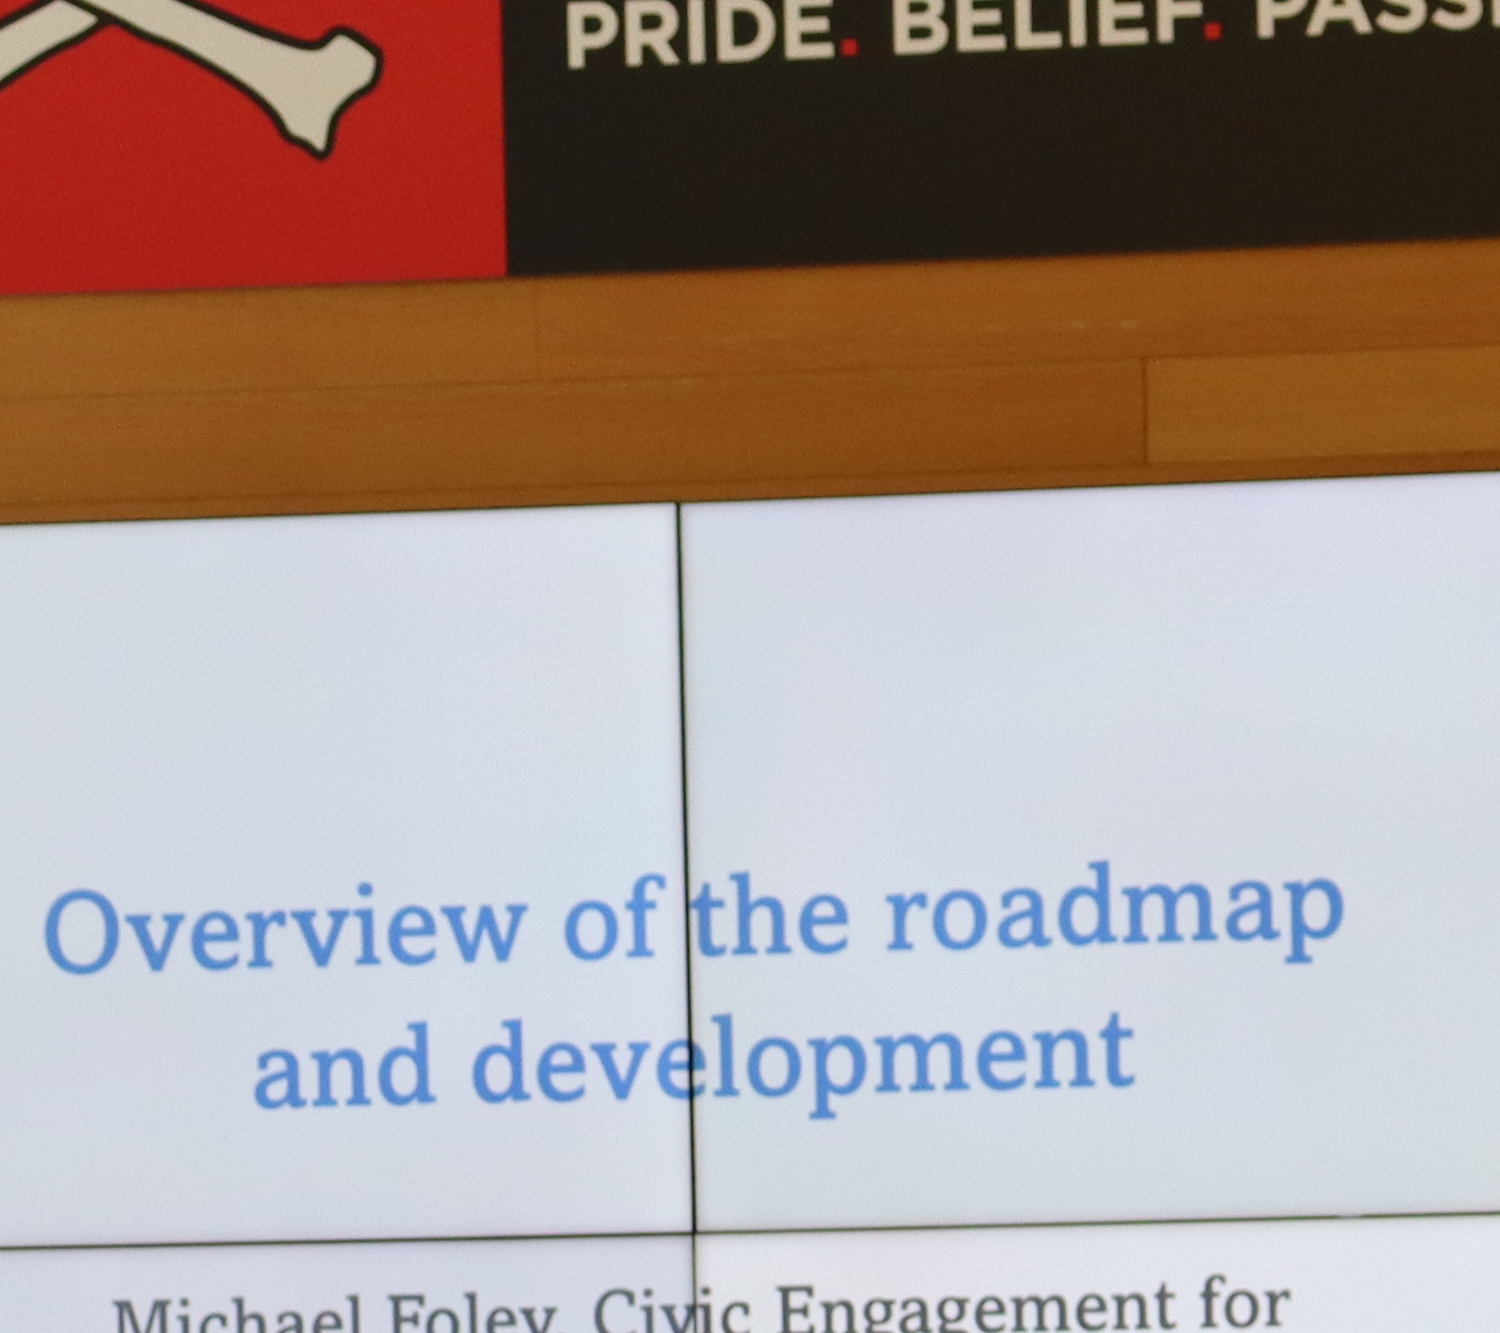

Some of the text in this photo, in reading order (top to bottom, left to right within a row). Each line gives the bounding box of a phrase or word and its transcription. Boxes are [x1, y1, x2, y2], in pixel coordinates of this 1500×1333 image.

[566, 0, 859, 70] PRIDE.
[891, 0, 1221, 57] BELIEF.
[42, 861, 1345, 976] Overview of the roadmap
[253, 1010, 1136, 1120] and development
[1199, 1274, 1293, 1330] for
